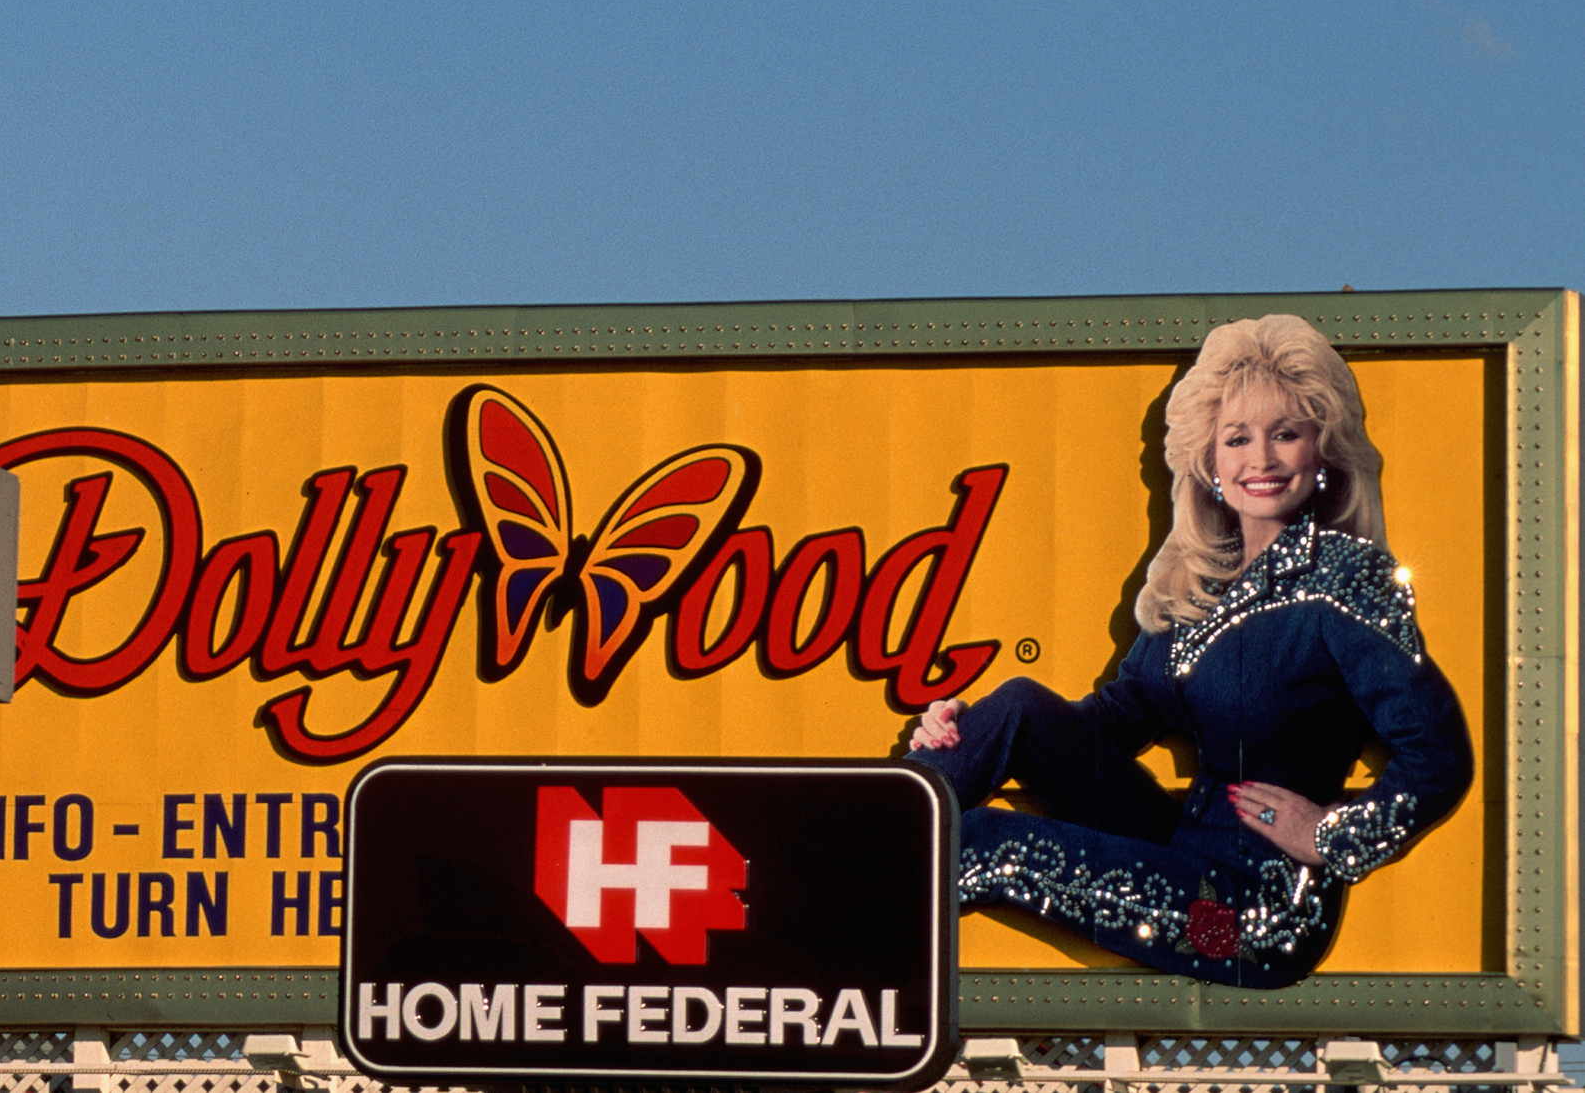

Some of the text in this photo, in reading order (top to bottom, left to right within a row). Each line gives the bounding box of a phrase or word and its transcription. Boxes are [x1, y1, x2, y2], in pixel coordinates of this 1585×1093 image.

[48, 870, 230, 939] TURN
[358, 981, 925, 1048] HOME FEDERAL
